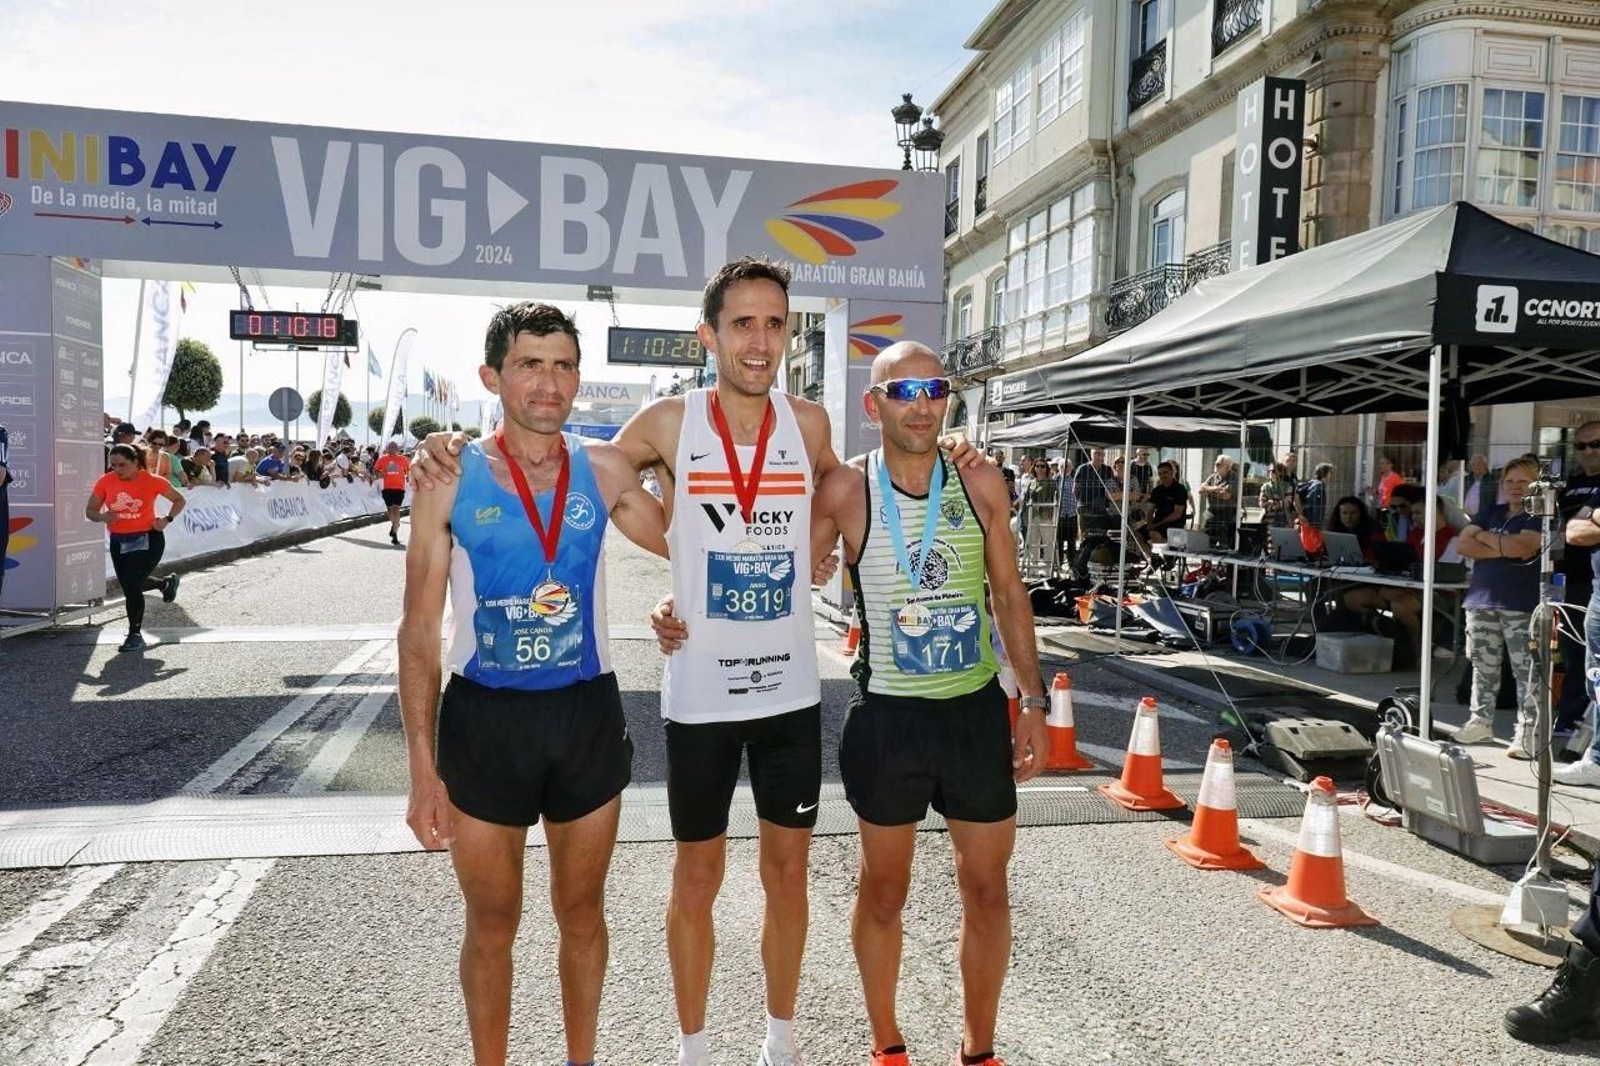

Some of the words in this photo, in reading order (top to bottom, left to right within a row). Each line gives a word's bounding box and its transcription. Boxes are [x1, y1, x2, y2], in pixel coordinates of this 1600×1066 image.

[5, 129, 237, 193] INIBAY
[1239, 90, 1258, 270] HOTE
[1268, 87, 1296, 261] HOTE
[31, 186, 54, 205] De
[59, 188, 76, 207] la
[83, 193, 141, 214] media,
[147, 195, 163, 213] la
[169, 199, 218, 216] mitad
[270, 136, 467, 266] VIG
[540, 155, 754, 278] BAY
[475, 244, 513, 265] 2024
[850, 266, 885, 286] GRAN
[888, 265, 926, 289] BAHÍA
[623, 337, 701, 358] 1:10:28
[745, 526, 788, 536] FOODS
[733, 562, 750, 574] VIG
[754, 561, 772, 574] BAY
[725, 588, 784, 613] 3819
[505, 606, 523, 620] VIG
[937, 615, 956, 627] BAY
[513, 628, 528, 636] JOSE
[516, 635, 551, 662] 56
[921, 640, 963, 667] 171
